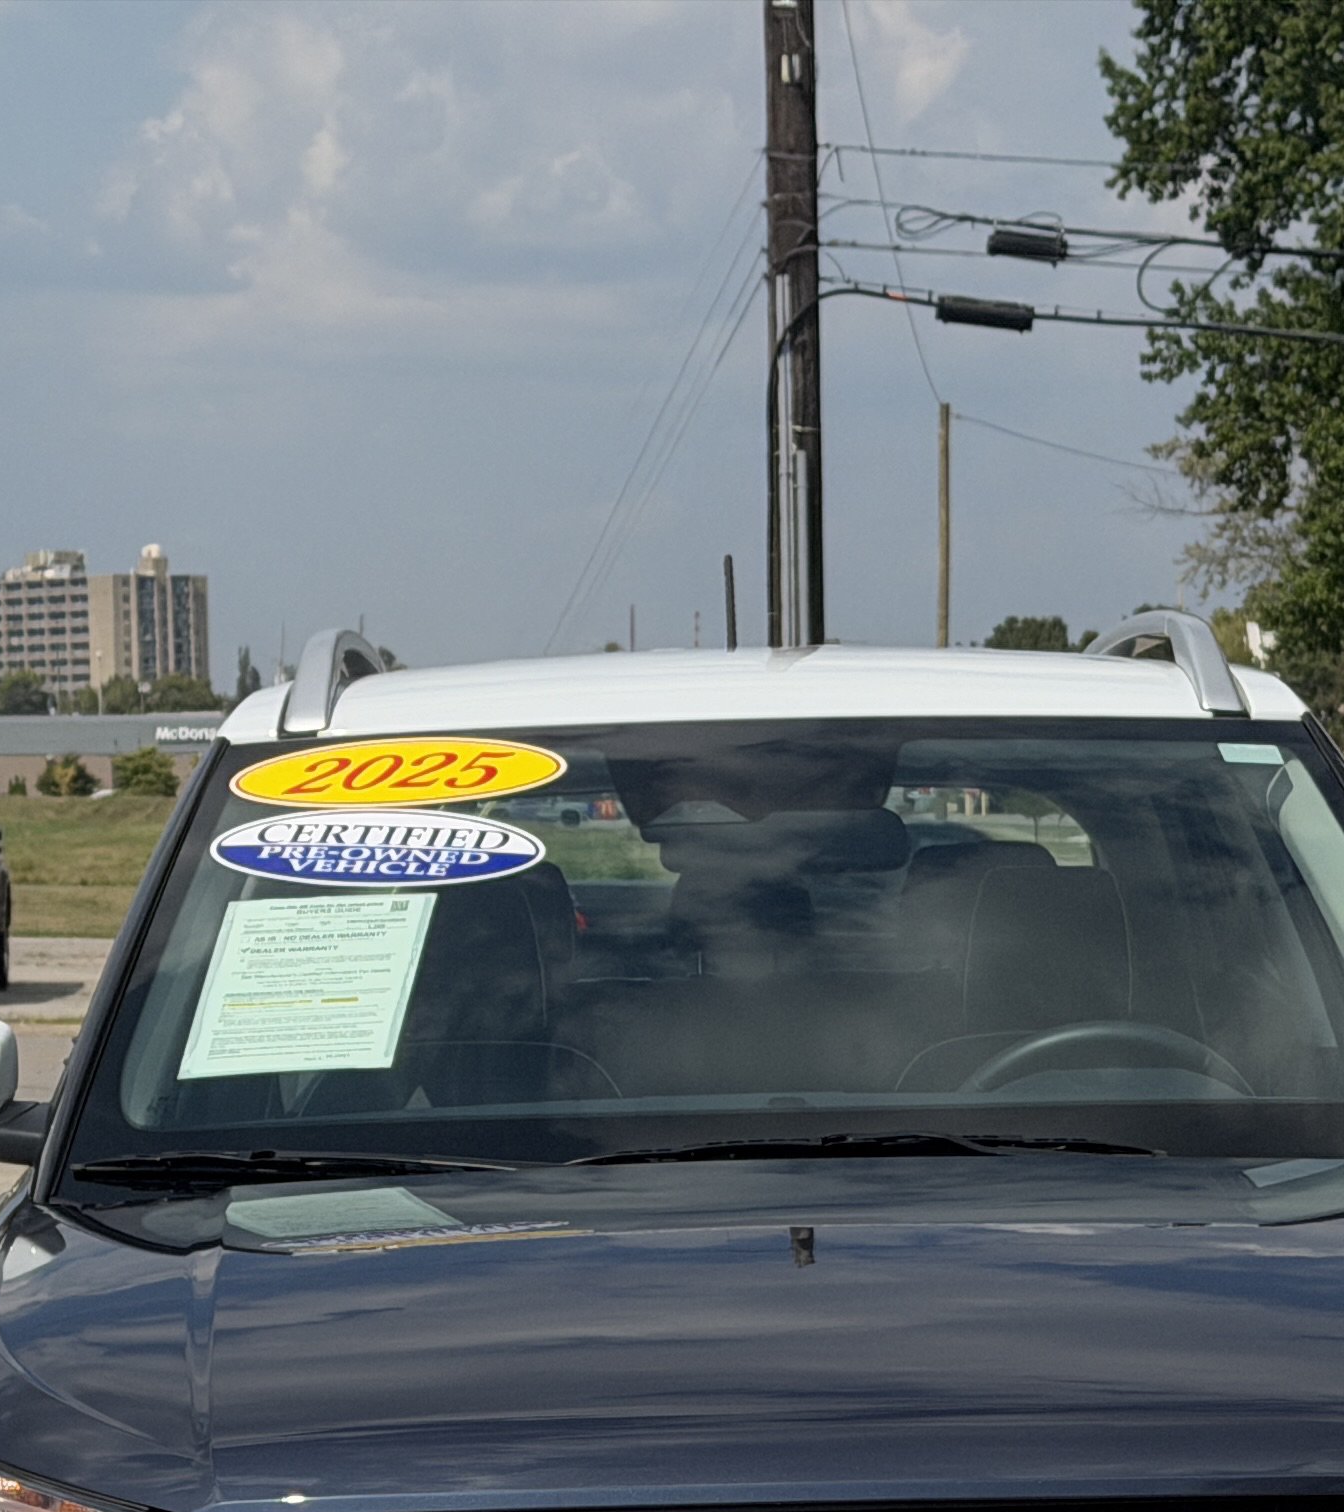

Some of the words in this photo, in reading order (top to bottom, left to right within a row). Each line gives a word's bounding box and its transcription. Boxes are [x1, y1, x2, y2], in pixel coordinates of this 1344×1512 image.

[280, 751, 516, 796] 2025
[257, 823, 510, 850] CERTIFIED
[257, 846, 490, 865] PRE-OWNED
[289, 858, 451, 876] VEHICLE
